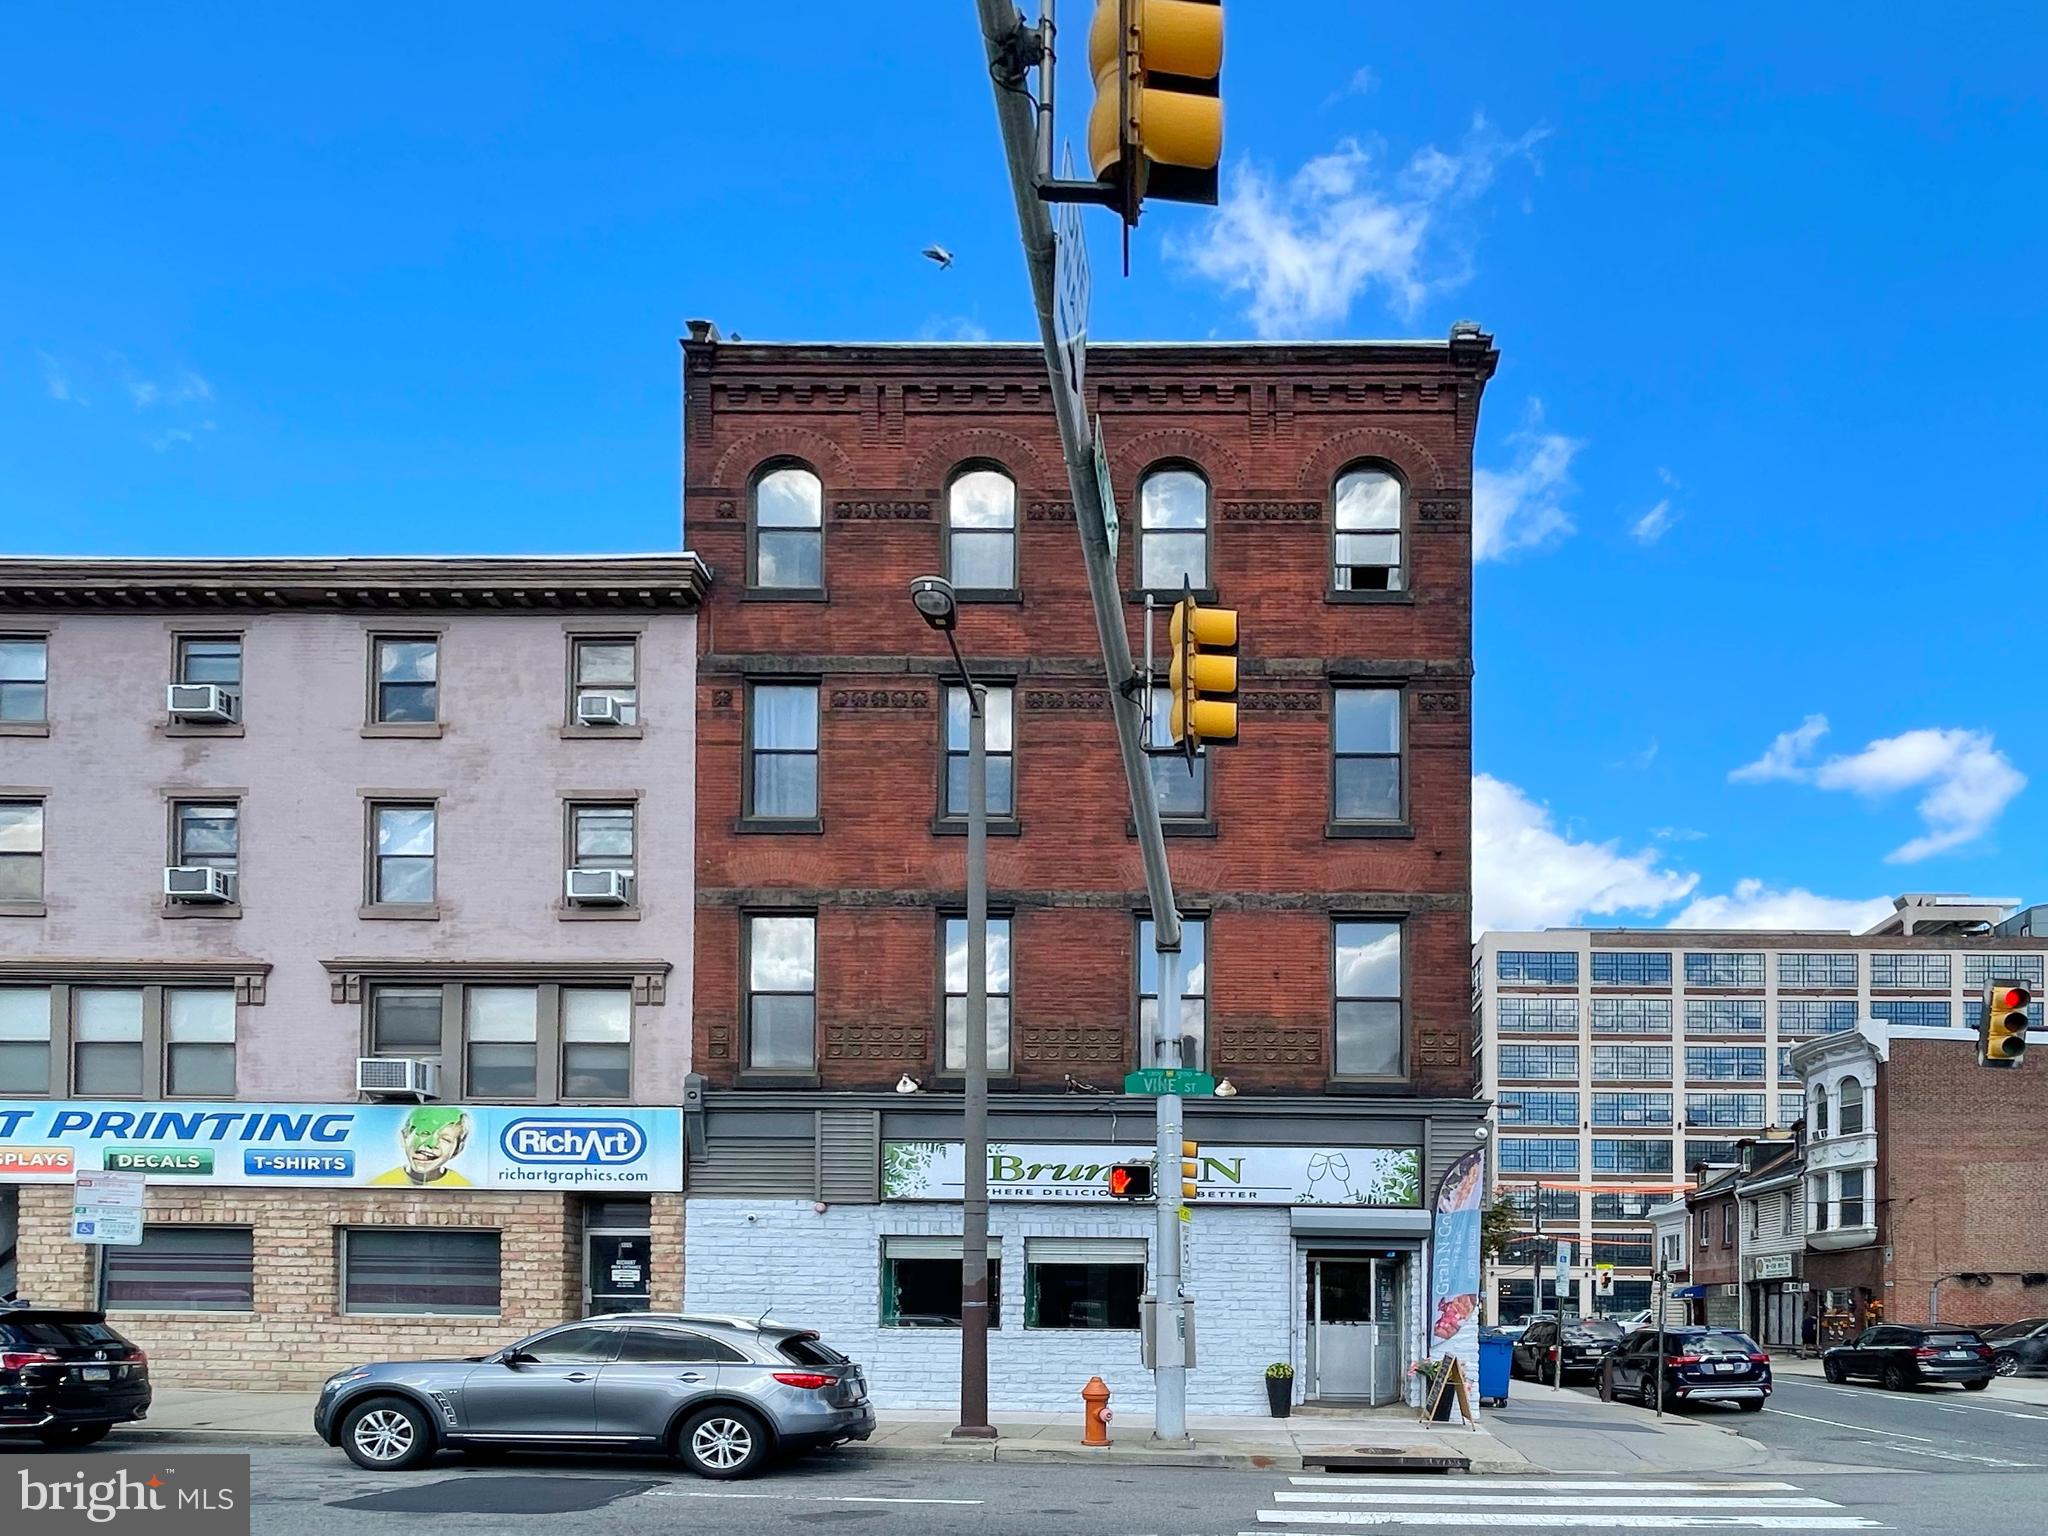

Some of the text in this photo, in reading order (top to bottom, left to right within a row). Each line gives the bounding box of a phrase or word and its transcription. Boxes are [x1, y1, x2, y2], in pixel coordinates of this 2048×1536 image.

[1143, 1078, 1197, 1093] VINE ST
[47, 1111, 355, 1143] PRINTING
[518, 1129, 628, 1157] RichArt
[117, 1154, 201, 1169] DECALS
[253, 1156, 347, 1171] T-SHIRTS
[498, 1166, 649, 1185] richartgraphics.com
[987, 1188, 1035, 1196] HERE
[1197, 1191, 1258, 1199] BETTER
